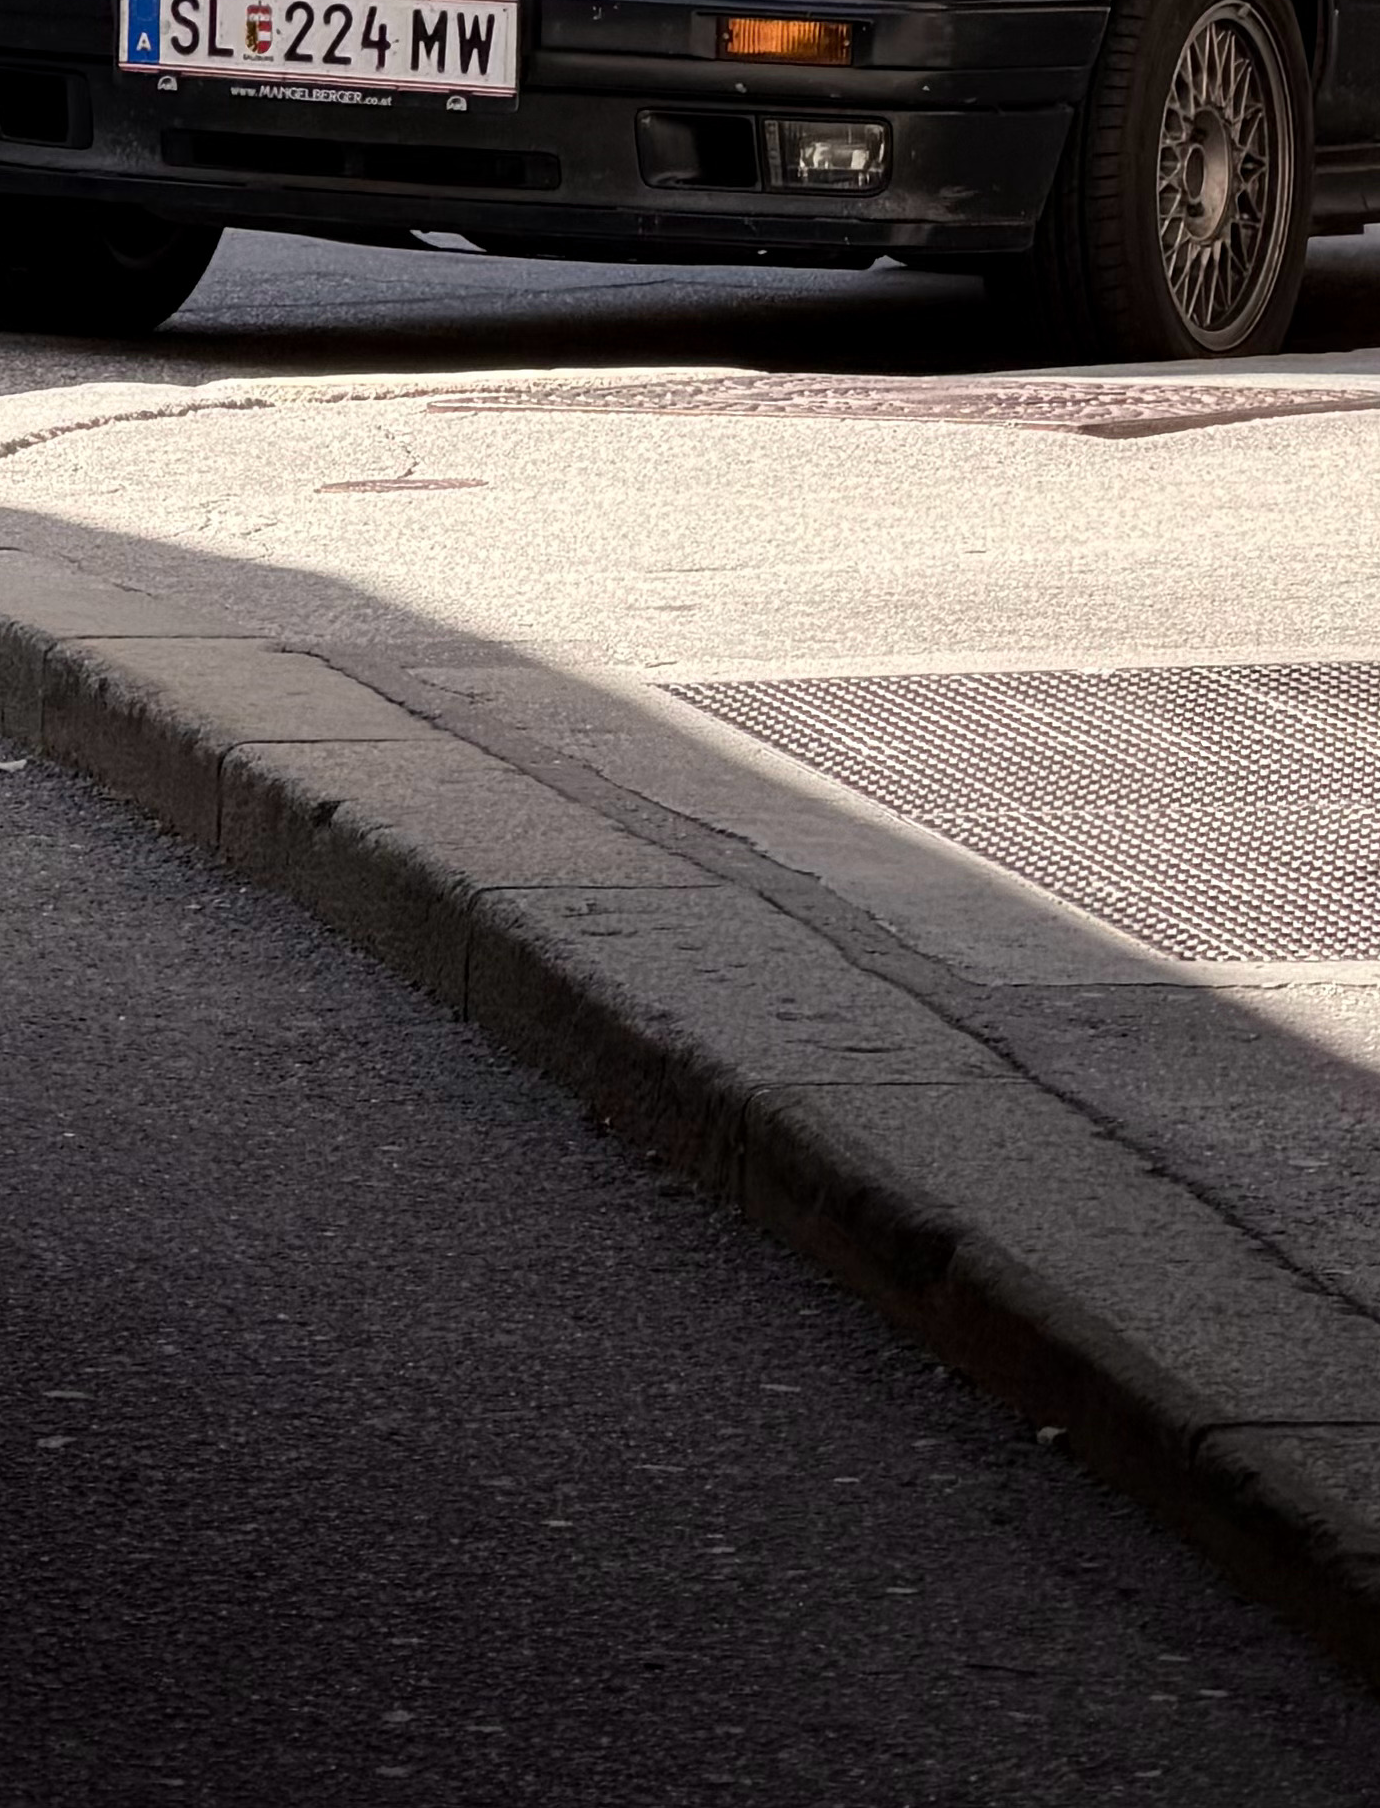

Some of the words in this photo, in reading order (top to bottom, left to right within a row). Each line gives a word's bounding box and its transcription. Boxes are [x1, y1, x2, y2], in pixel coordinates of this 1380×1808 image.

[136, 31, 153, 52] A
[283, 0, 392, 72] 224
[410, 7, 496, 76] MW
